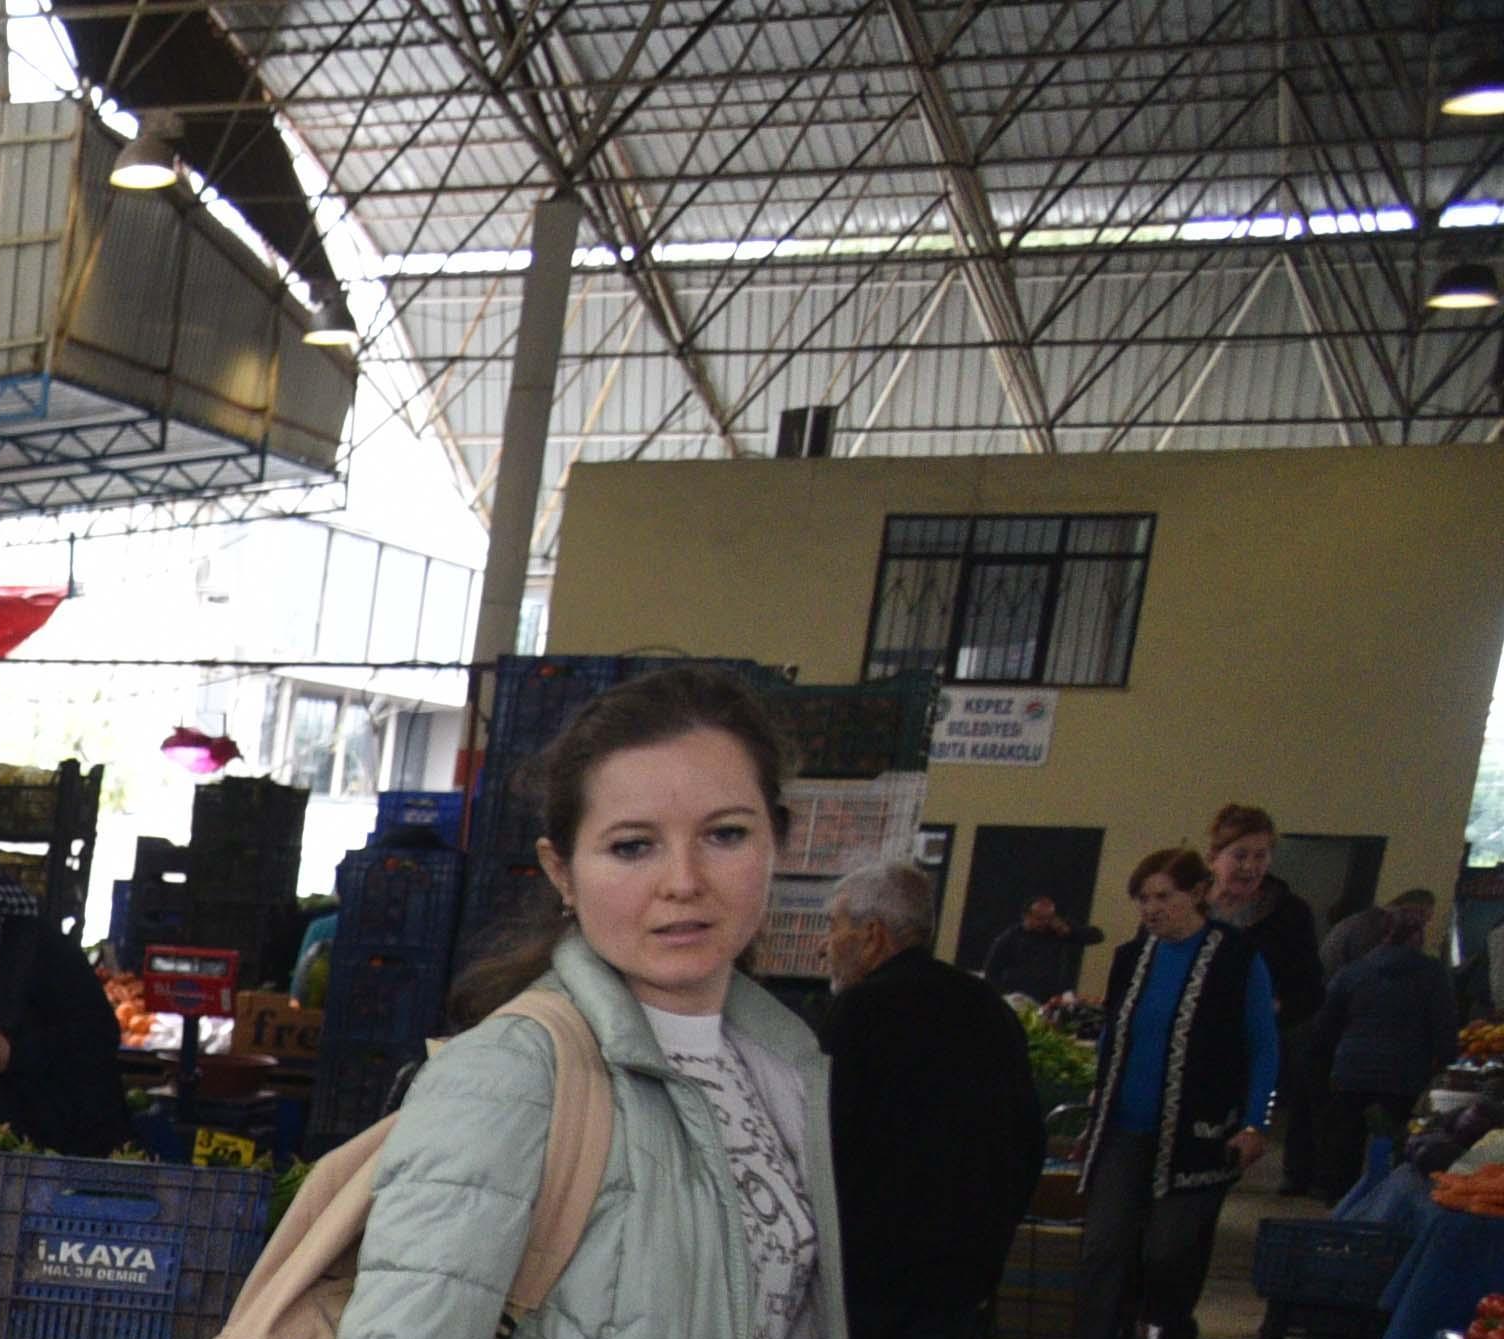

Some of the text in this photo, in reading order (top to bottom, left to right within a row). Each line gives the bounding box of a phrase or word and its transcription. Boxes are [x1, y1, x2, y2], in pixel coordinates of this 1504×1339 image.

[963, 697, 1015, 715] KEPEZ
[970, 743, 1044, 761] KARAKOLU
[96, 1268, 149, 1284] DEMRE
